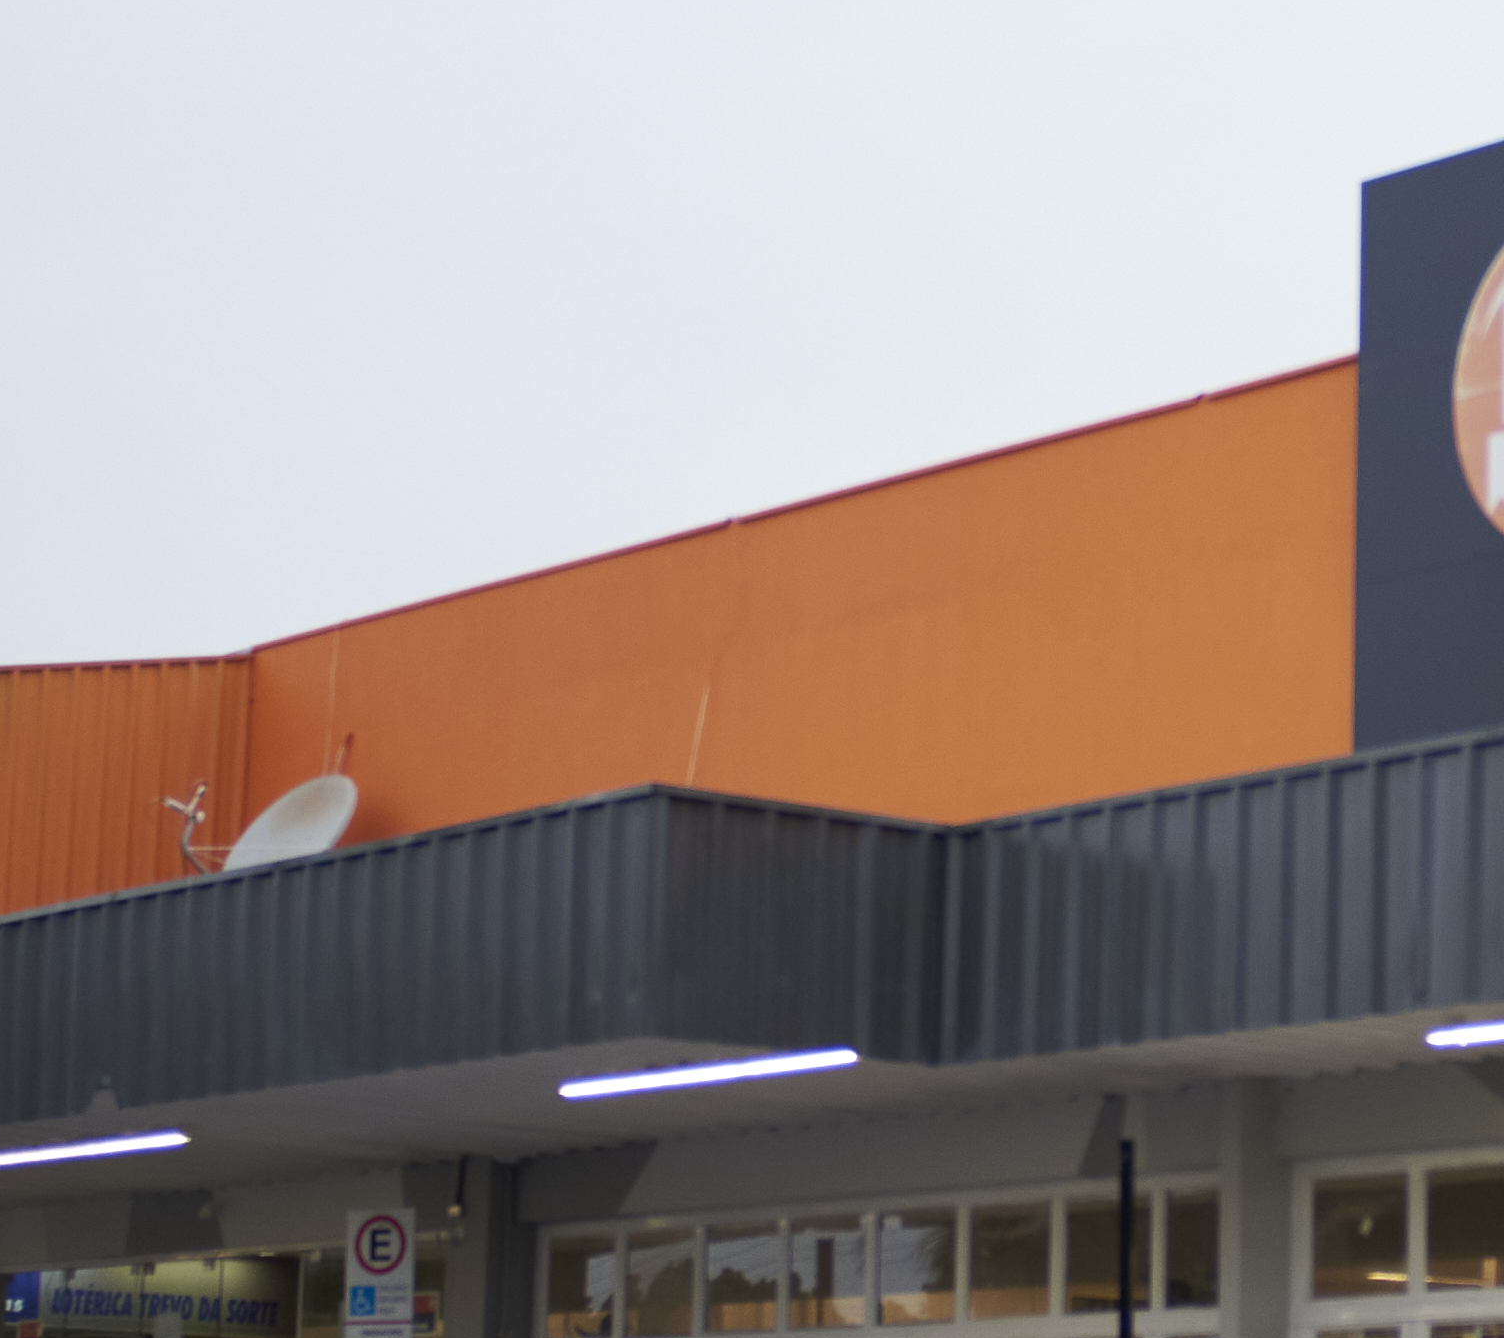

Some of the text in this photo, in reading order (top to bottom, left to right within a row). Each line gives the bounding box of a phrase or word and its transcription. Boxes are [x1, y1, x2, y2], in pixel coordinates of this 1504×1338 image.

[370, 1228, 392, 1261] E
[199, 1295, 221, 1323] DA
[225, 1299, 280, 1327] SORTE
